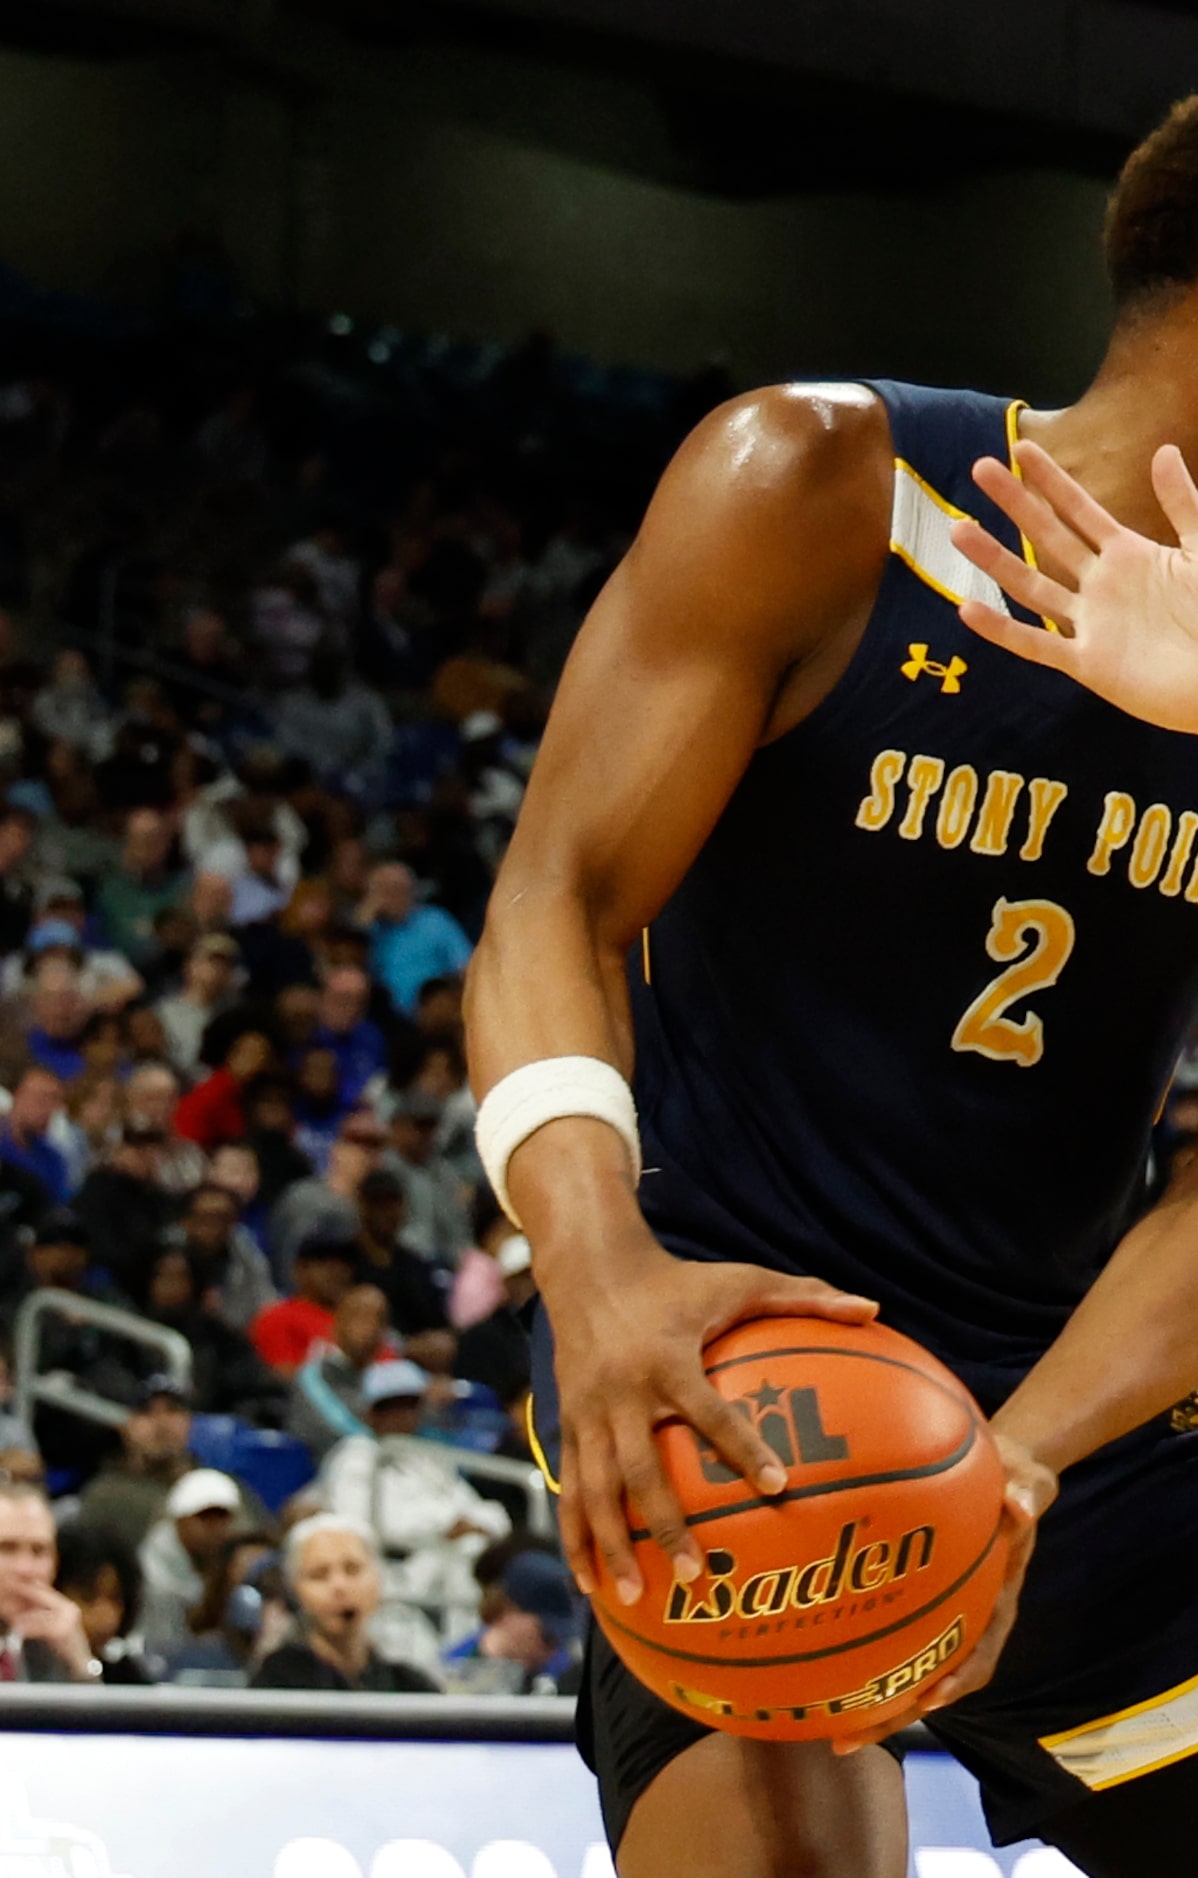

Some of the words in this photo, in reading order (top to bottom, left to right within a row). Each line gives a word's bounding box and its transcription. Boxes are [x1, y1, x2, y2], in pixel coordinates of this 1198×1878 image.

[855, 749, 1068, 862] STONY
[949, 896, 1076, 1068] 2
[662, 1519, 936, 1624] Baden
[719, 1591, 898, 1641] PERFECTION
[883, 1620, 963, 1702] PRO
